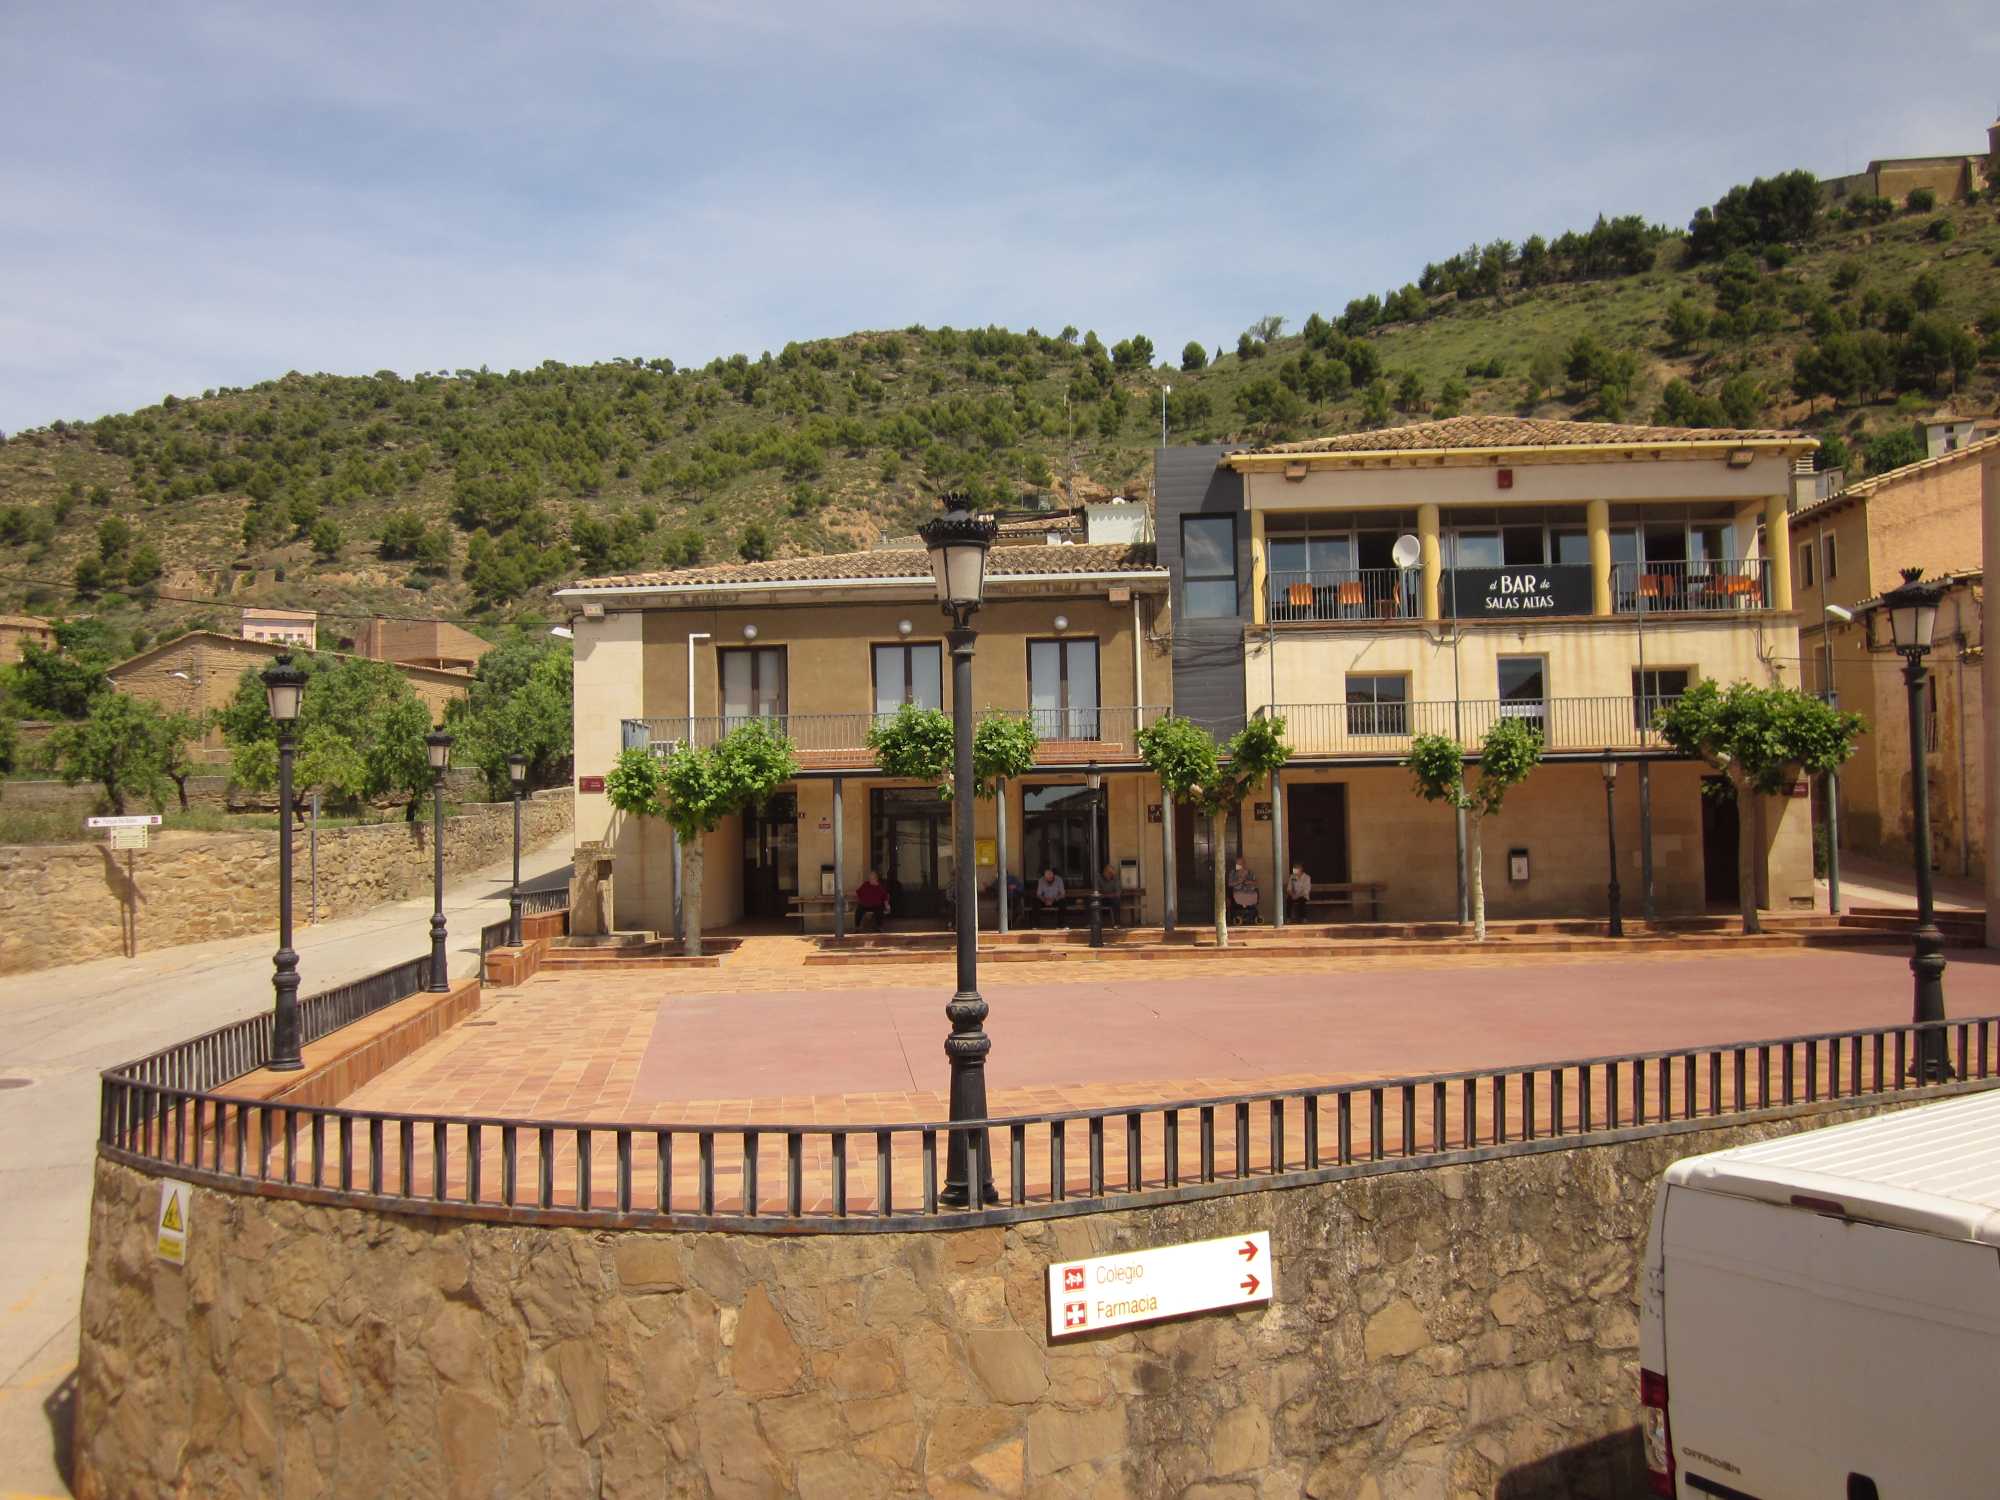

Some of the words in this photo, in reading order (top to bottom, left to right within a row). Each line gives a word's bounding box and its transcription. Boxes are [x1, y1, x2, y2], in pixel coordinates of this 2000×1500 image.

[1501, 574, 1536, 594] BAR
[1540, 578, 1550, 589] de
[1486, 596, 1520, 609] SALAS
[1523, 595, 1554, 608] ALTAS
[1096, 1262, 1144, 1285] Colegio
[1097, 1294, 1158, 1320] Farmacia
